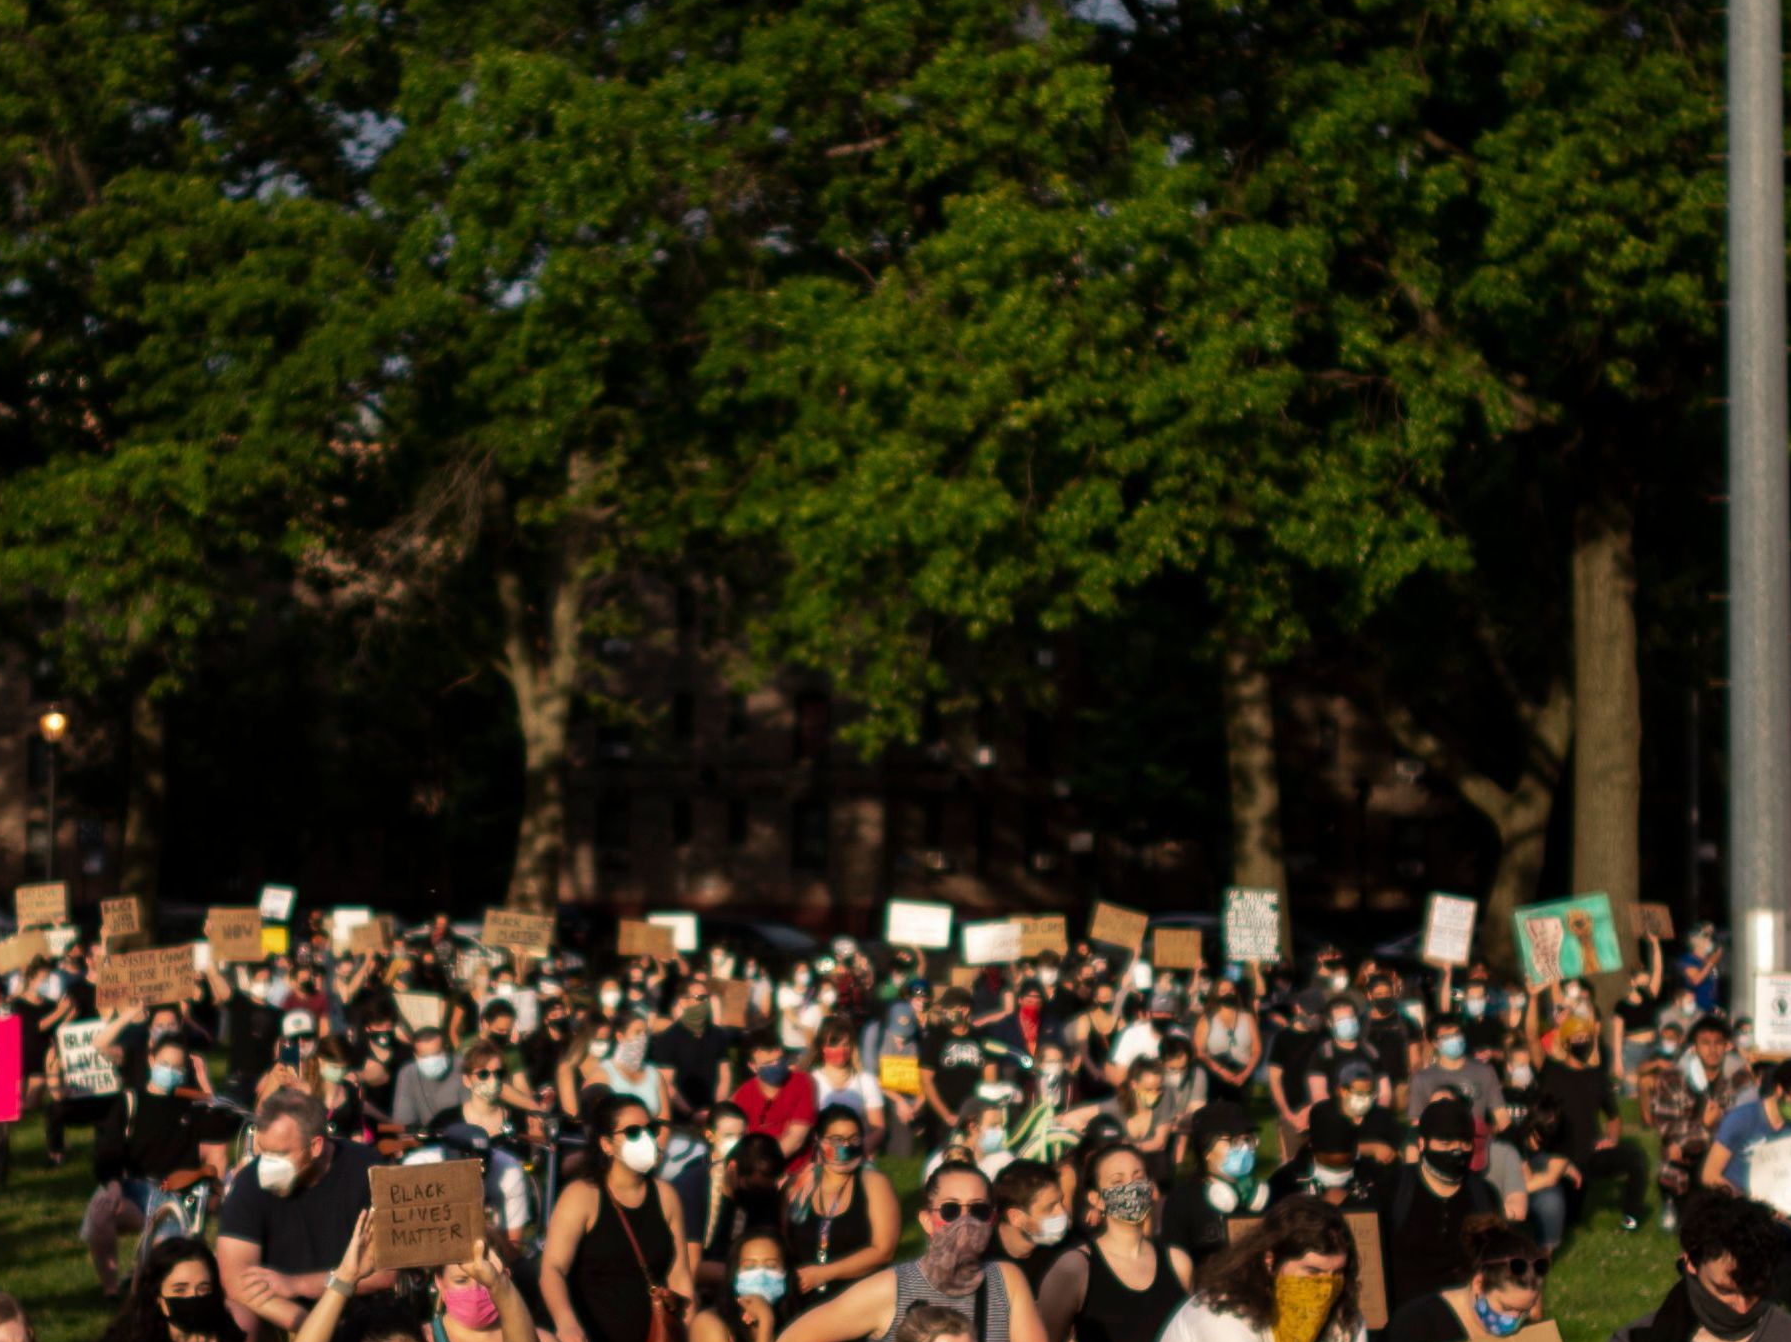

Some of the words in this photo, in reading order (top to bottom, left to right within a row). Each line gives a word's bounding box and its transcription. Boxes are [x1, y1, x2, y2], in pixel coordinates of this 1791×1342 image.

[390, 1182, 446, 1205] BLACK
[391, 1203, 453, 1224] LIVES
[390, 1223, 463, 1246] MATTER
